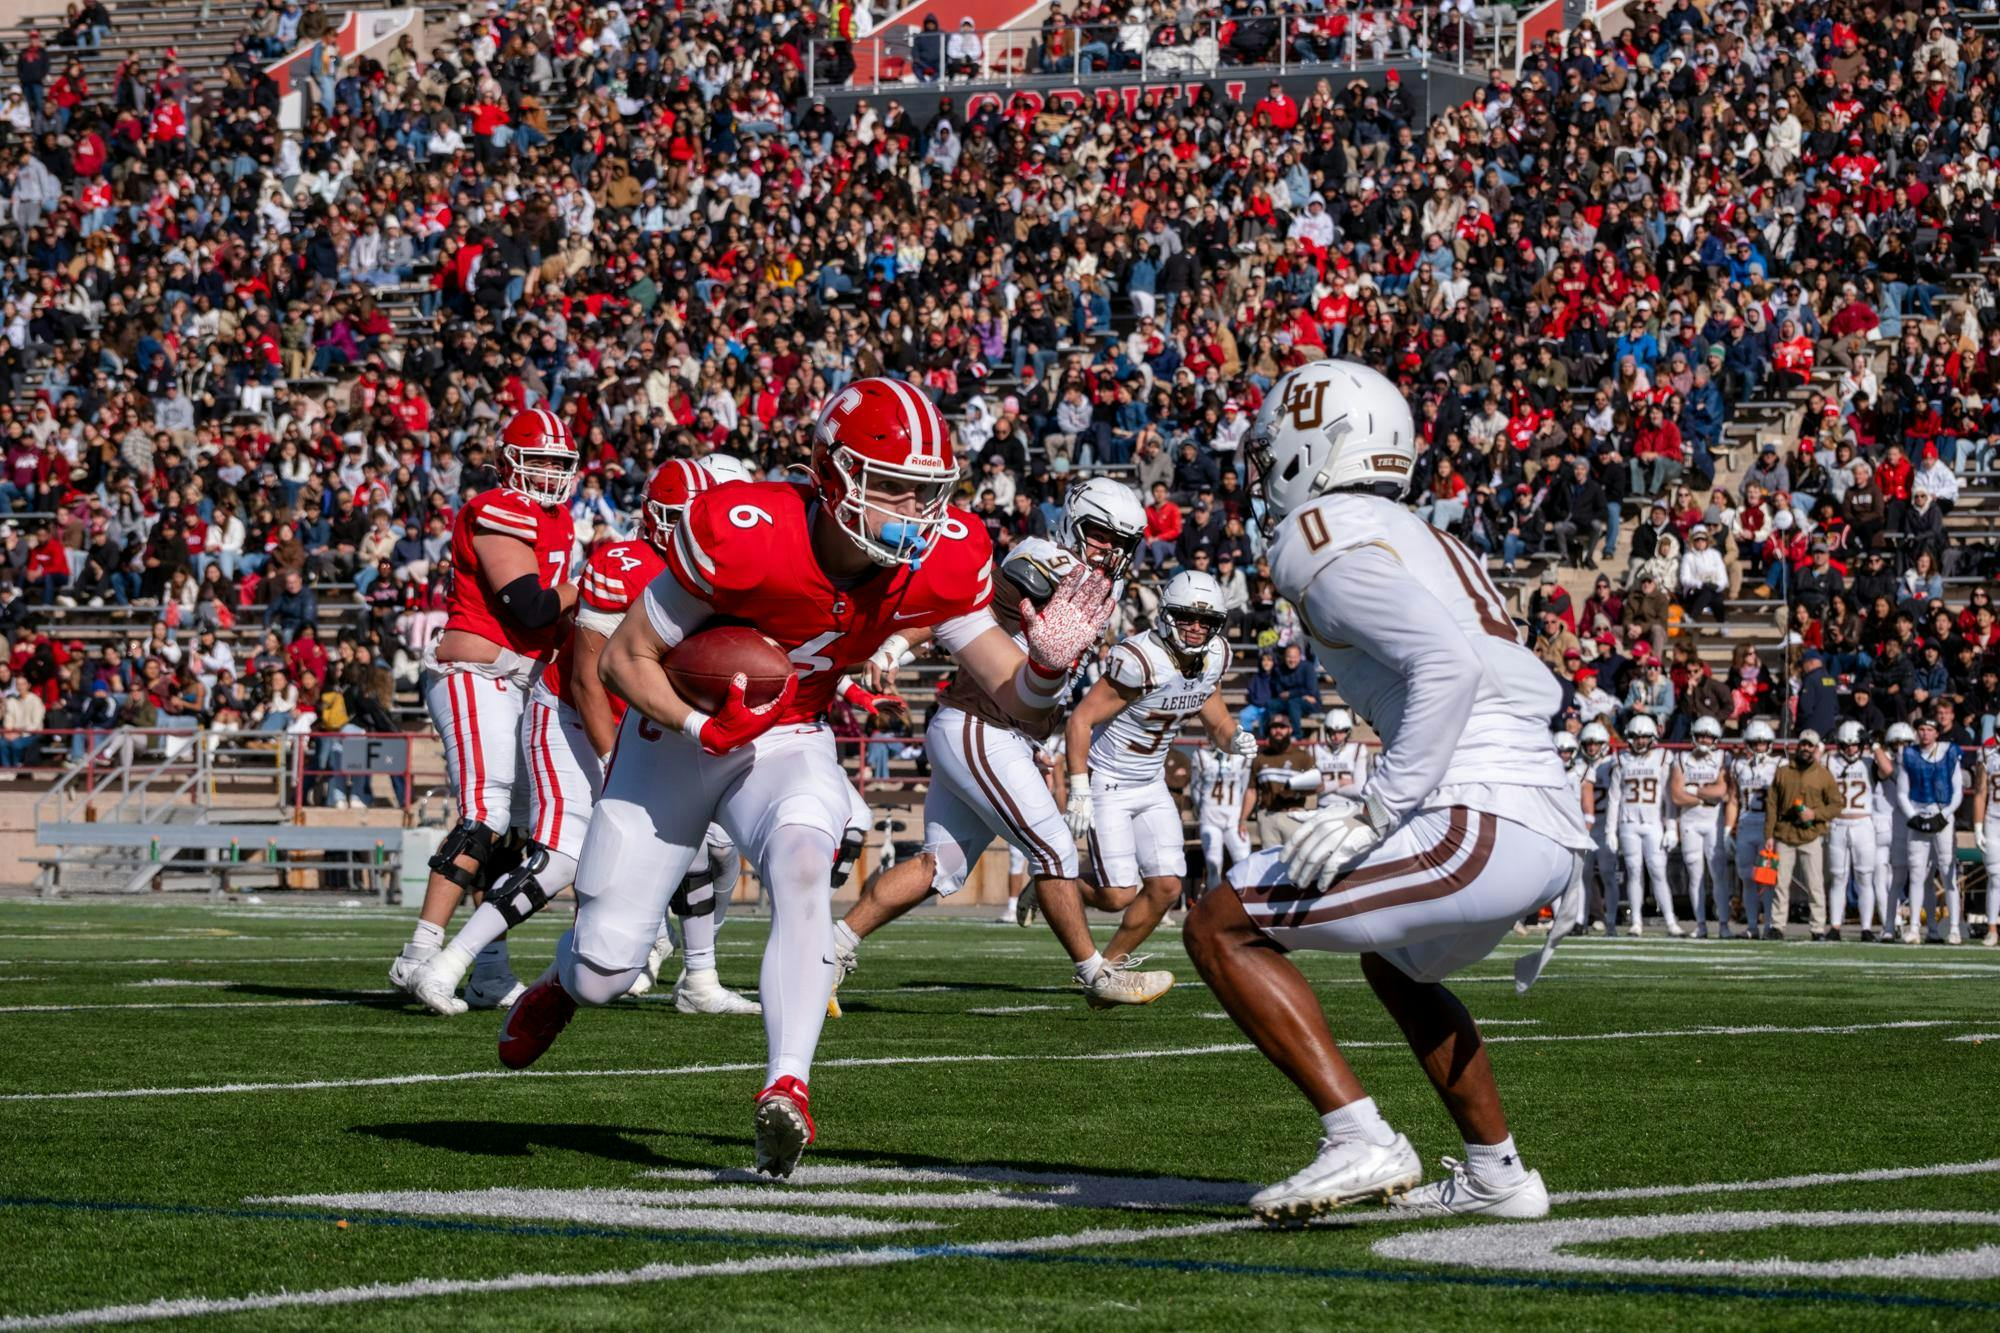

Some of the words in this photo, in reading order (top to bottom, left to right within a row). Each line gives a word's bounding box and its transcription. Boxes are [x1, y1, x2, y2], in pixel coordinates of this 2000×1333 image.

[1282, 372, 1331, 431] LU
[912, 457, 942, 468] Riddell
[607, 547, 642, 571] 64
[832, 602, 846, 614] C
[367, 742, 383, 769] F
[1211, 779, 1236, 806] 41
[1624, 778, 1658, 804] 39
